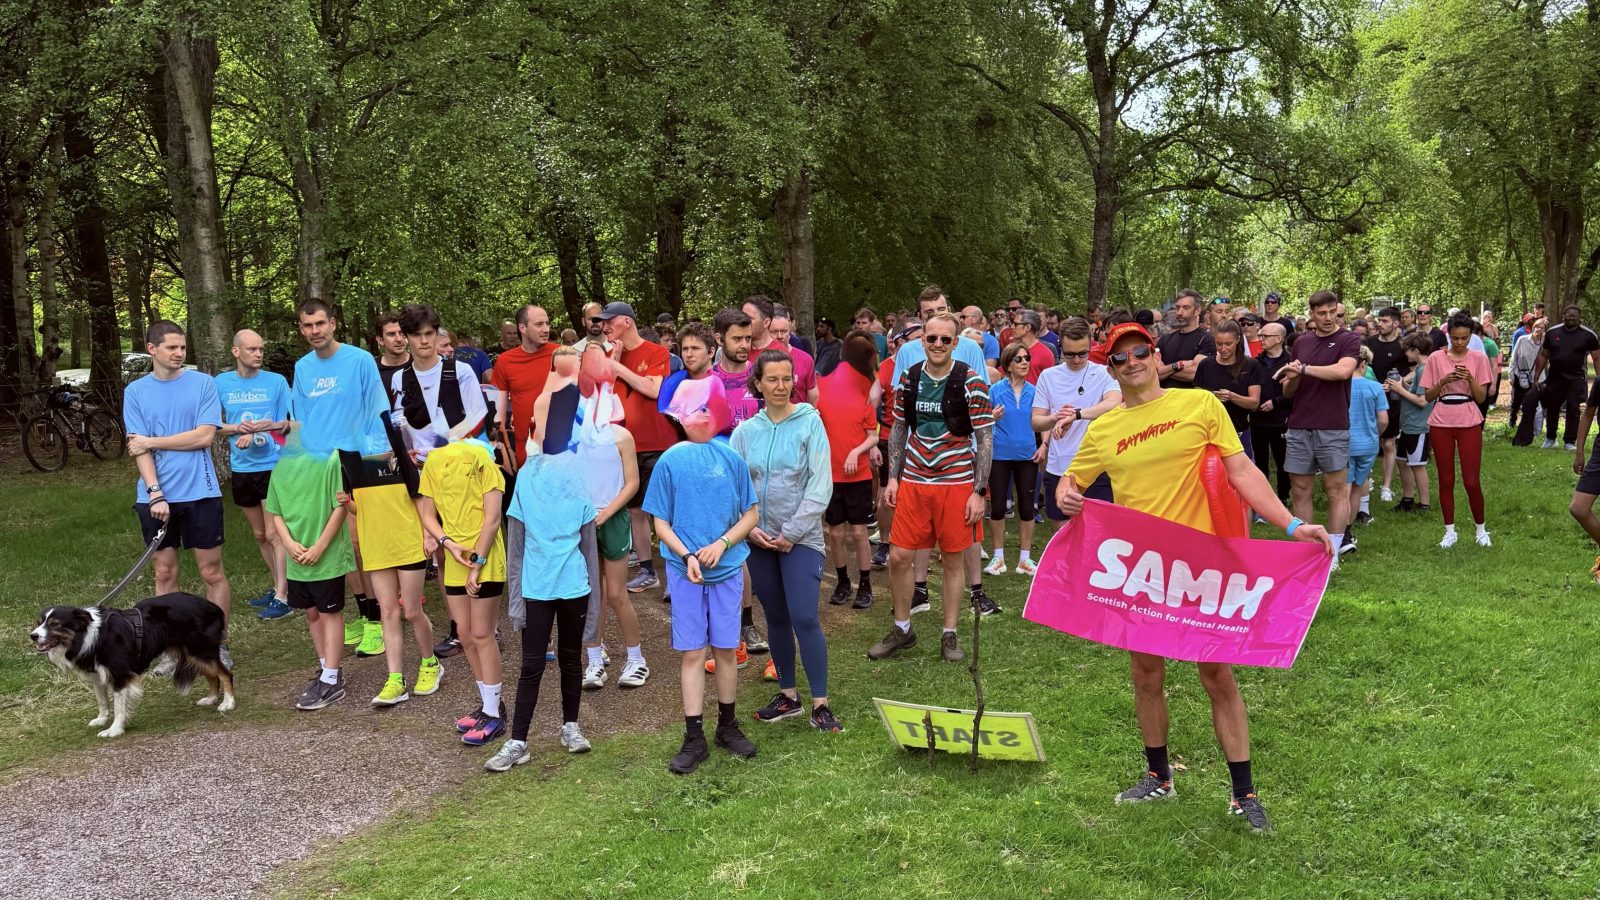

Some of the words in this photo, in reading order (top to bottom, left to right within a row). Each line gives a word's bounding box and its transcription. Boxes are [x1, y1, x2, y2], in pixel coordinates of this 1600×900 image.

[915, 401, 943, 413] TERPIL
[1115, 418, 1183, 456] BAYWATCH
[1089, 538, 1275, 621] SAMH
[1086, 592, 1128, 610] Scottish
[1129, 604, 1163, 619] Action
[1165, 613, 1180, 623] for
[1181, 617, 1216, 630] Mental
[1217, 623, 1249, 633] Health
